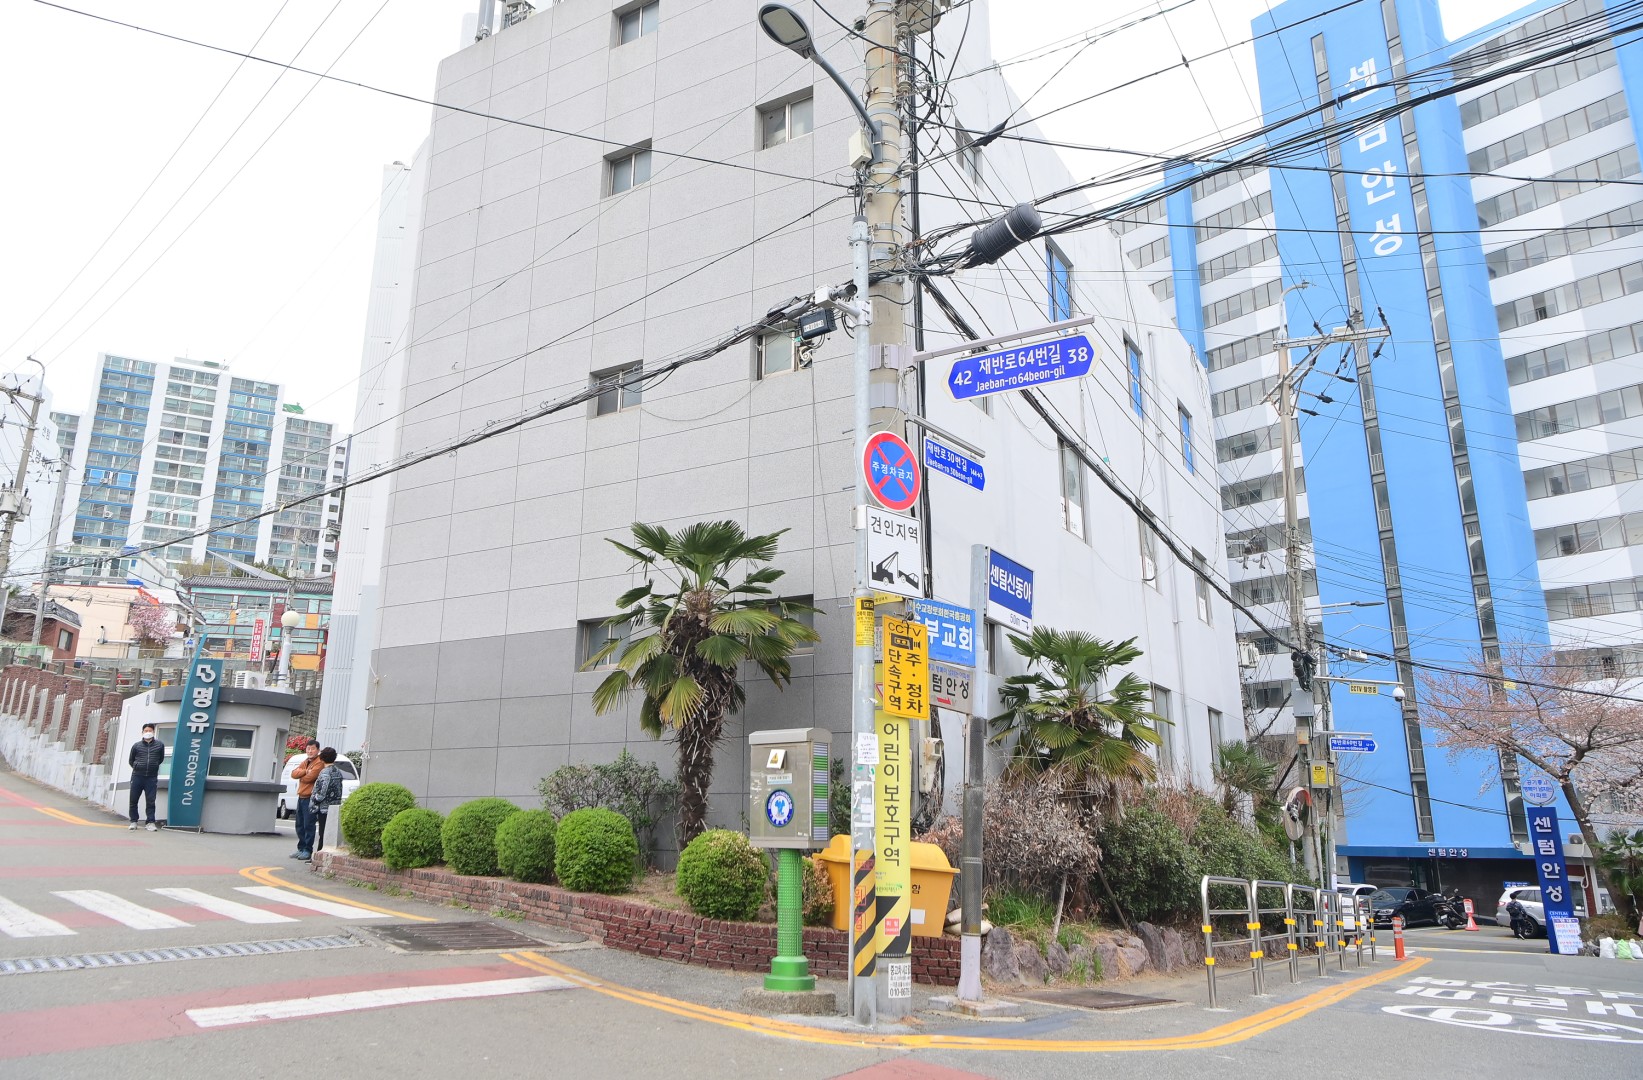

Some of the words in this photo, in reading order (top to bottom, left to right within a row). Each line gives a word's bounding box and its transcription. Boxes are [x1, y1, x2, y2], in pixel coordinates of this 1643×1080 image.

[954, 370, 972, 385] 42
[978, 343, 1061, 375] 재반로64번길
[1067, 347, 1088, 364] 38
[872, 461, 913, 482] 주정차금지
[926, 441, 967, 472] 재반로30번길
[871, 516, 918, 544] 견인지역
[990, 564, 1032, 604] 센텀신동아
[888, 622, 921, 637] CCTV
[1010, 613, 1021, 627] 50m
[888, 648, 902, 711] 단속구역
[932, 673, 970, 700] 텀안성
[186, 687, 214, 734] 명유
[184, 738, 201, 787] MYEONG
[181, 791, 193, 806] YU
[883, 723, 900, 867] 어린이보호구역
[1427, 848, 1468, 857] 센텀안성
[1533, 816, 1564, 903] 센텀안성
[1428, 1008, 1621, 1040] 30
